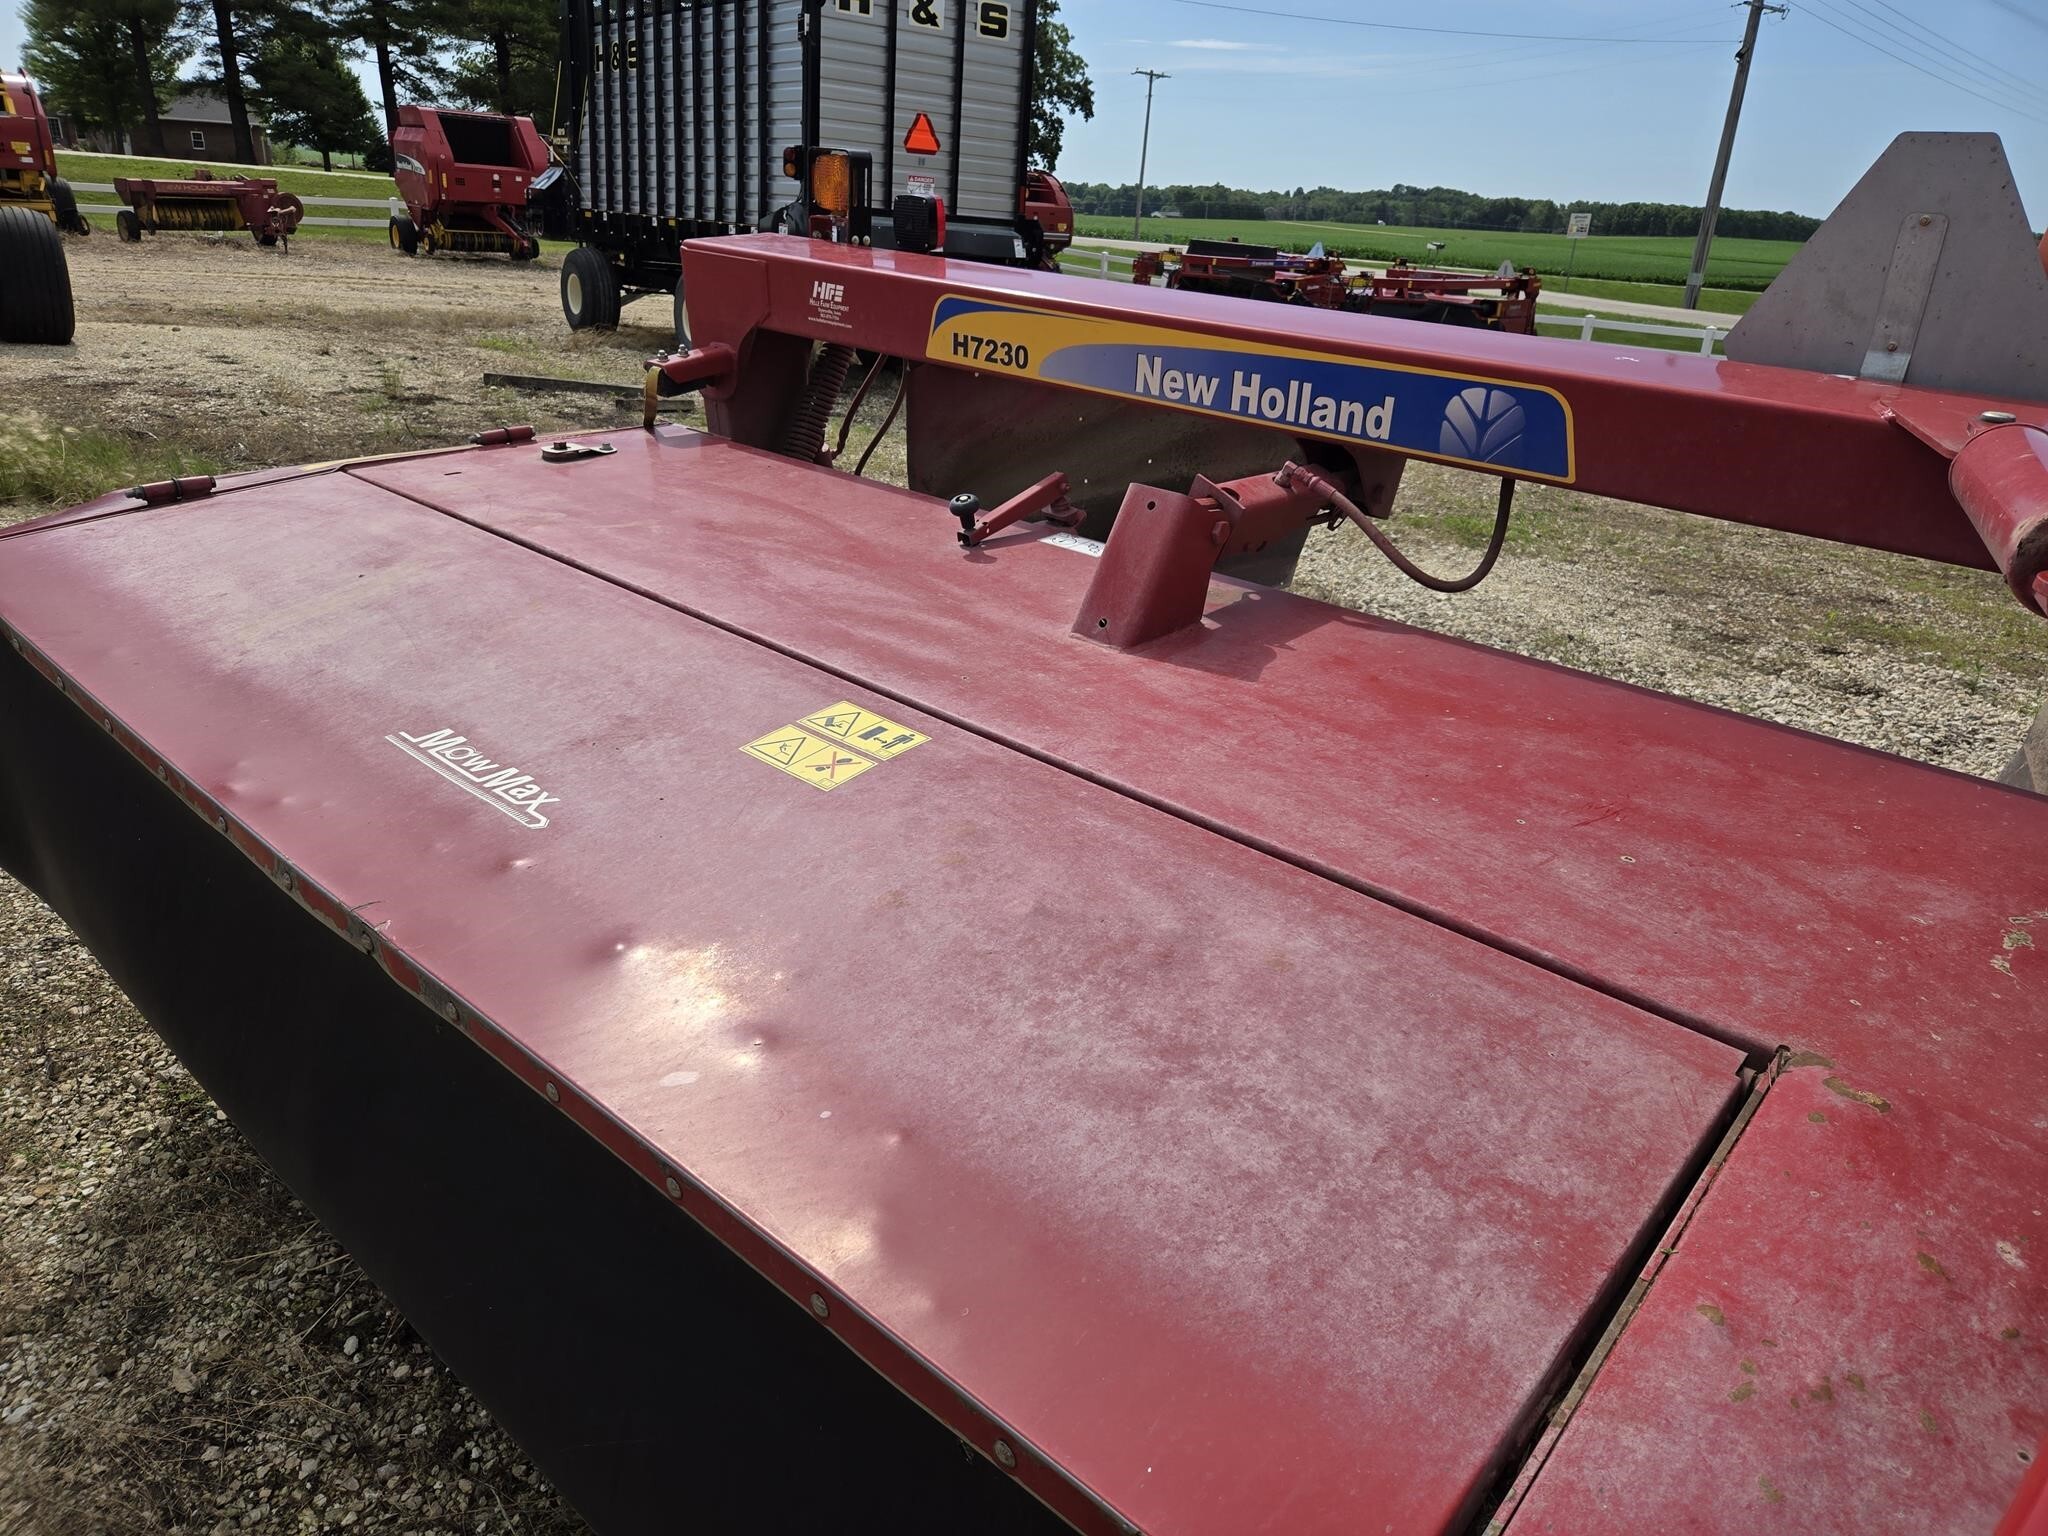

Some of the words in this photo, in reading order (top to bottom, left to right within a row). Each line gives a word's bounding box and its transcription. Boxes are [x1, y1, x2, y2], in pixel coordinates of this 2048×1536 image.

[980, 2, 1008, 39] S
[952, 332, 1029, 370] H7230
[1135, 353, 1220, 407] New
[1230, 370, 1396, 441] Holland
